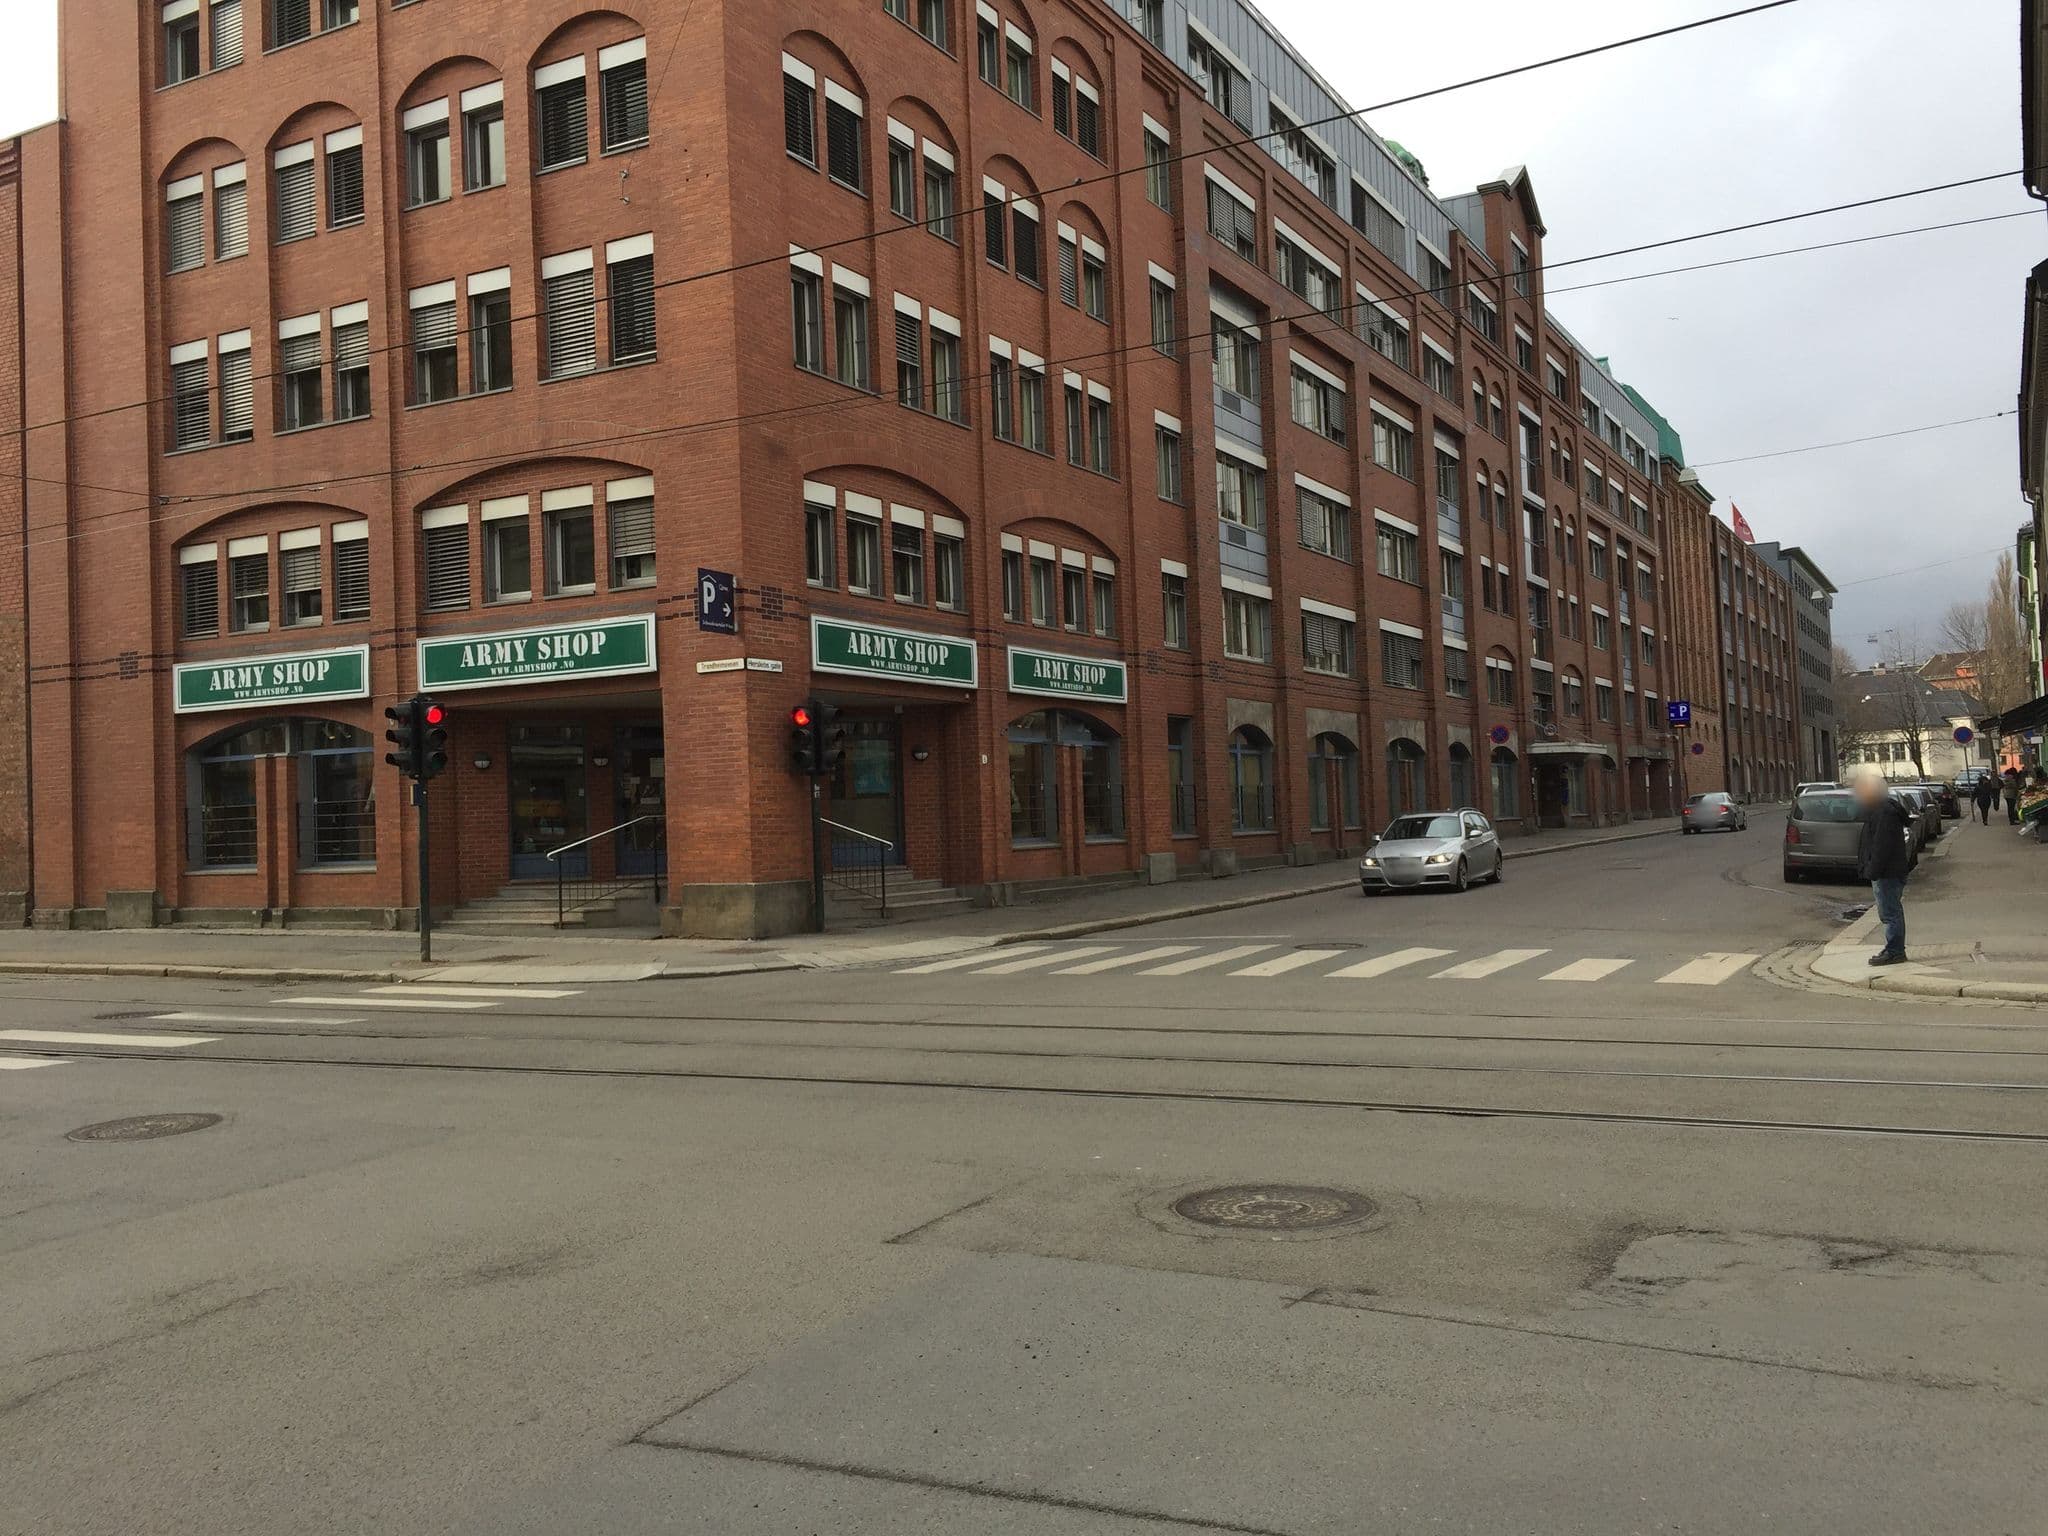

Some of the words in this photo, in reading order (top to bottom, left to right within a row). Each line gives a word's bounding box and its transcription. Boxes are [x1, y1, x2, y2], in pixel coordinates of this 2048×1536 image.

[703, 581, 716, 614] P
[460, 639, 528, 668] ARMY
[537, 631, 607, 660] SHOP
[848, 632, 897, 660] ARMY
[904, 641, 949, 665] SHOP
[209, 665, 265, 692] ARMY
[272, 659, 330, 686] SHOP
[1033, 658, 1069, 680] ARMY
[1073, 664, 1106, 685] SHOP
[1680, 706, 1687, 717] P
